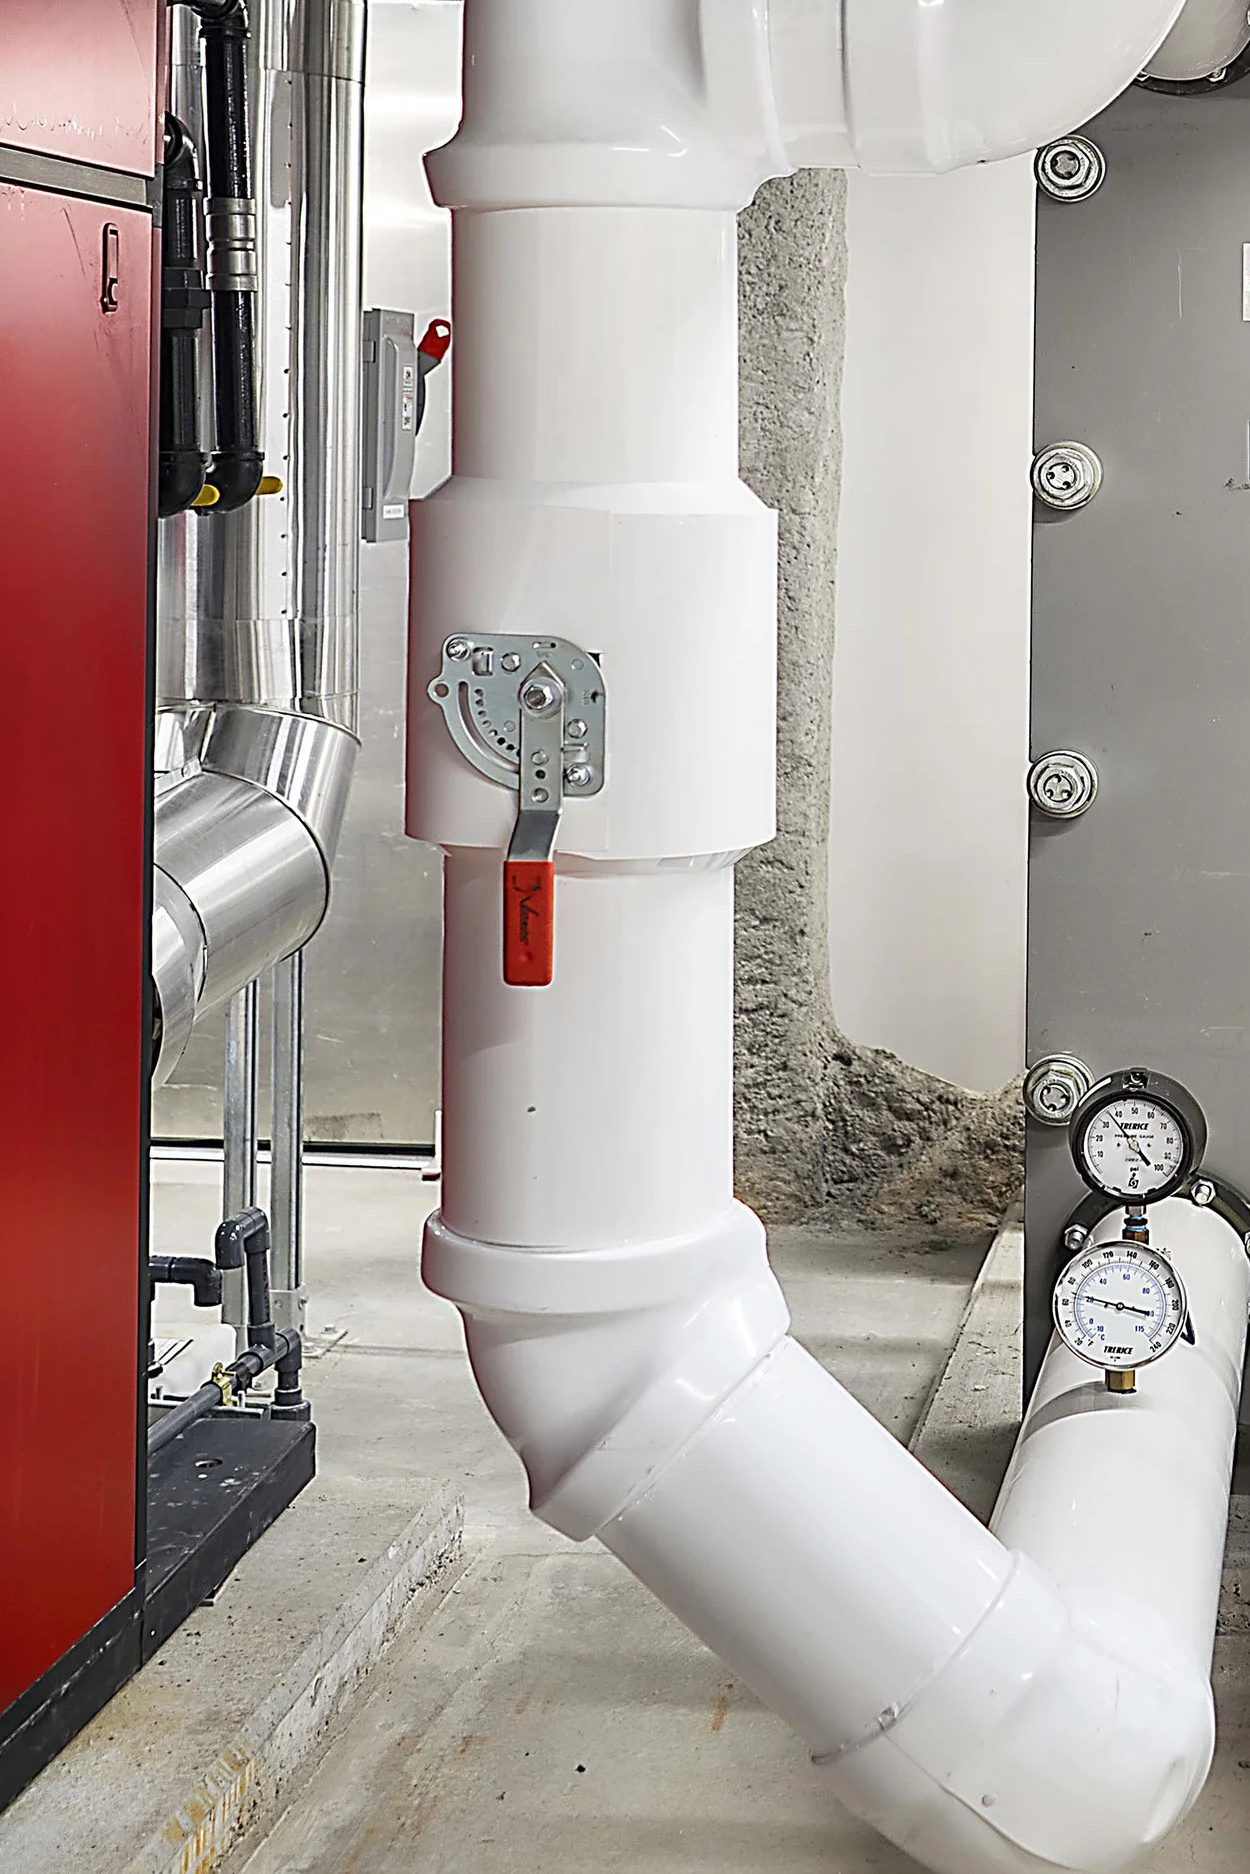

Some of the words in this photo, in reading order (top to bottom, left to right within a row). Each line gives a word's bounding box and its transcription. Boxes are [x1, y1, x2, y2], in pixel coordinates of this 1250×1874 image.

[1131, 1107, 1138, 1115] 50
[1103, 1251, 1113, 1259] 120
[1127, 1251, 1137, 1259] 140
[1082, 1259, 1093, 1268] 100
[1149, 1260, 1159, 1270] 160
[1165, 1277, 1175, 1288] 180
[1166, 1323, 1175, 1334] 220
[1074, 1337, 1083, 1346] 20
[1103, 1346, 1134, 1355] TRERICE
[1150, 1341, 1162, 1353] 240
